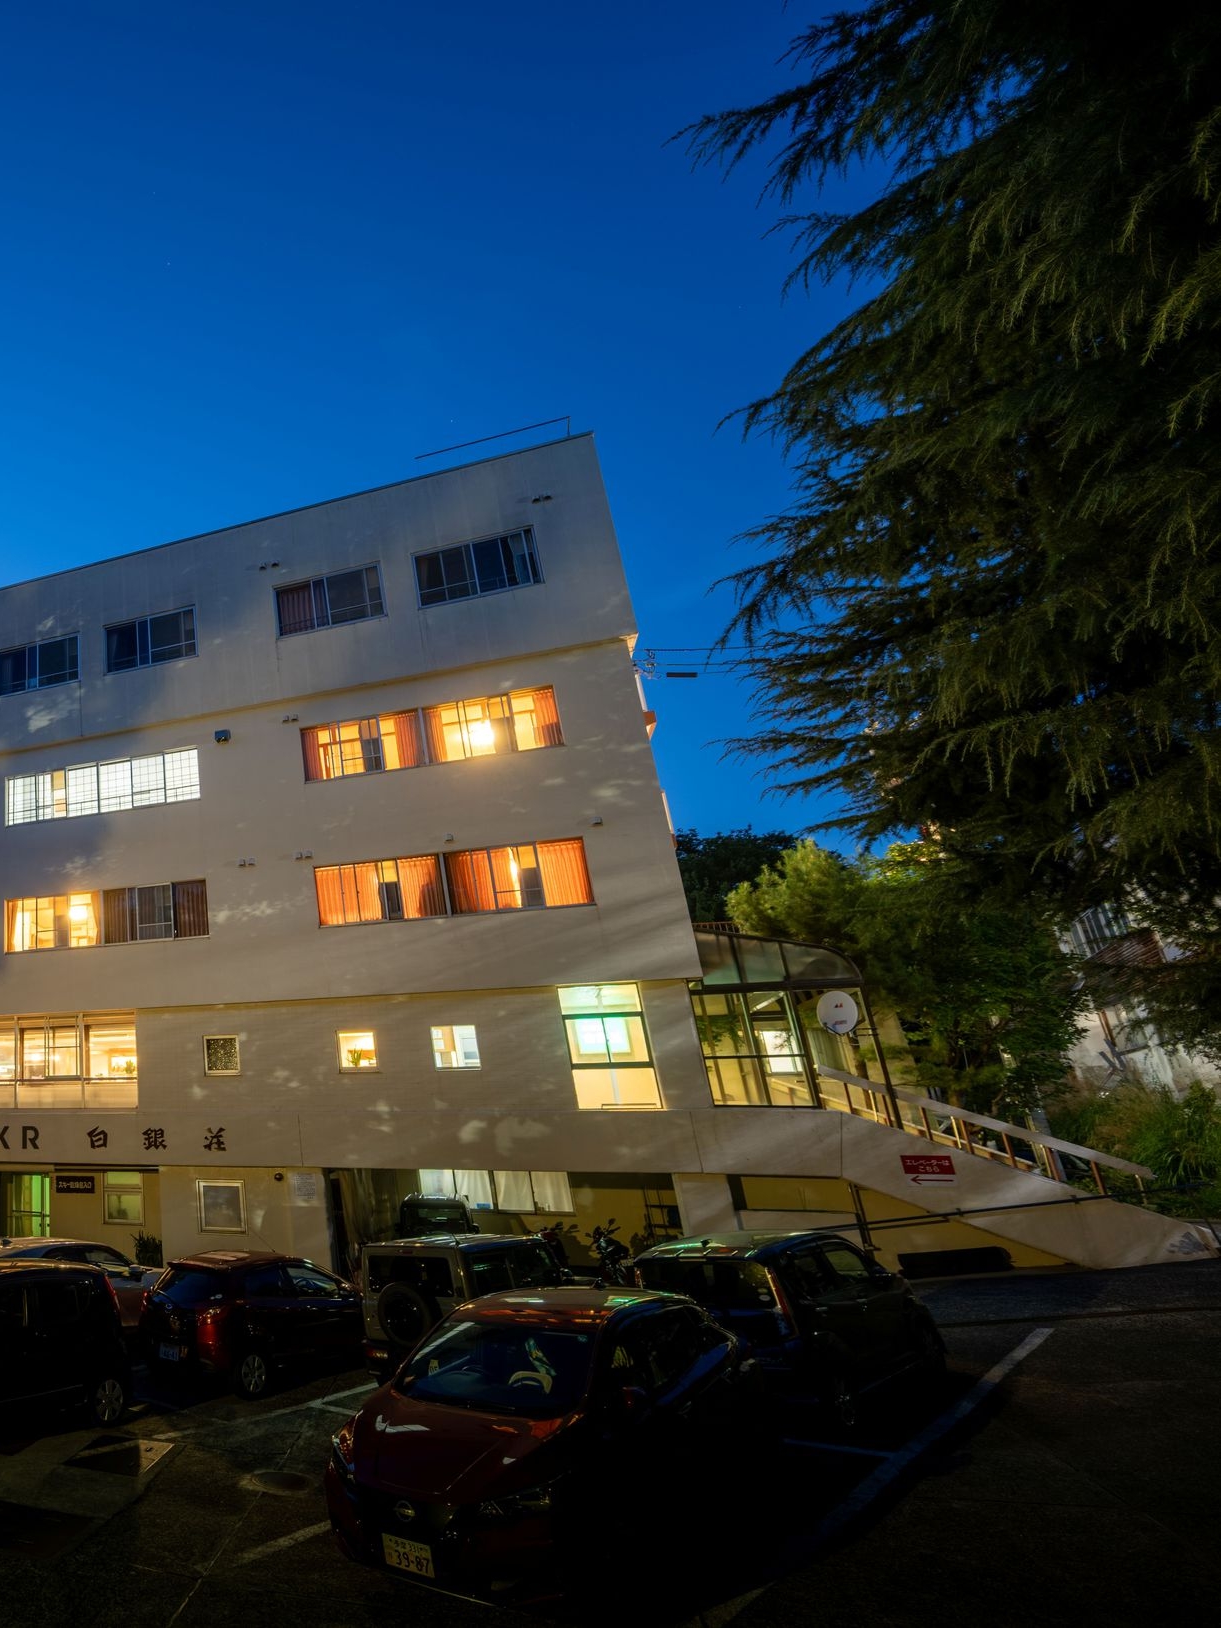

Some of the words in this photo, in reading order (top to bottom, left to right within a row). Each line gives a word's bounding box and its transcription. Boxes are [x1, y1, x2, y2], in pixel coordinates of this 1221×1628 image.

[87, 1125, 227, 1151] 白銀荘
[395, 1549, 429, 1575] 39-87
